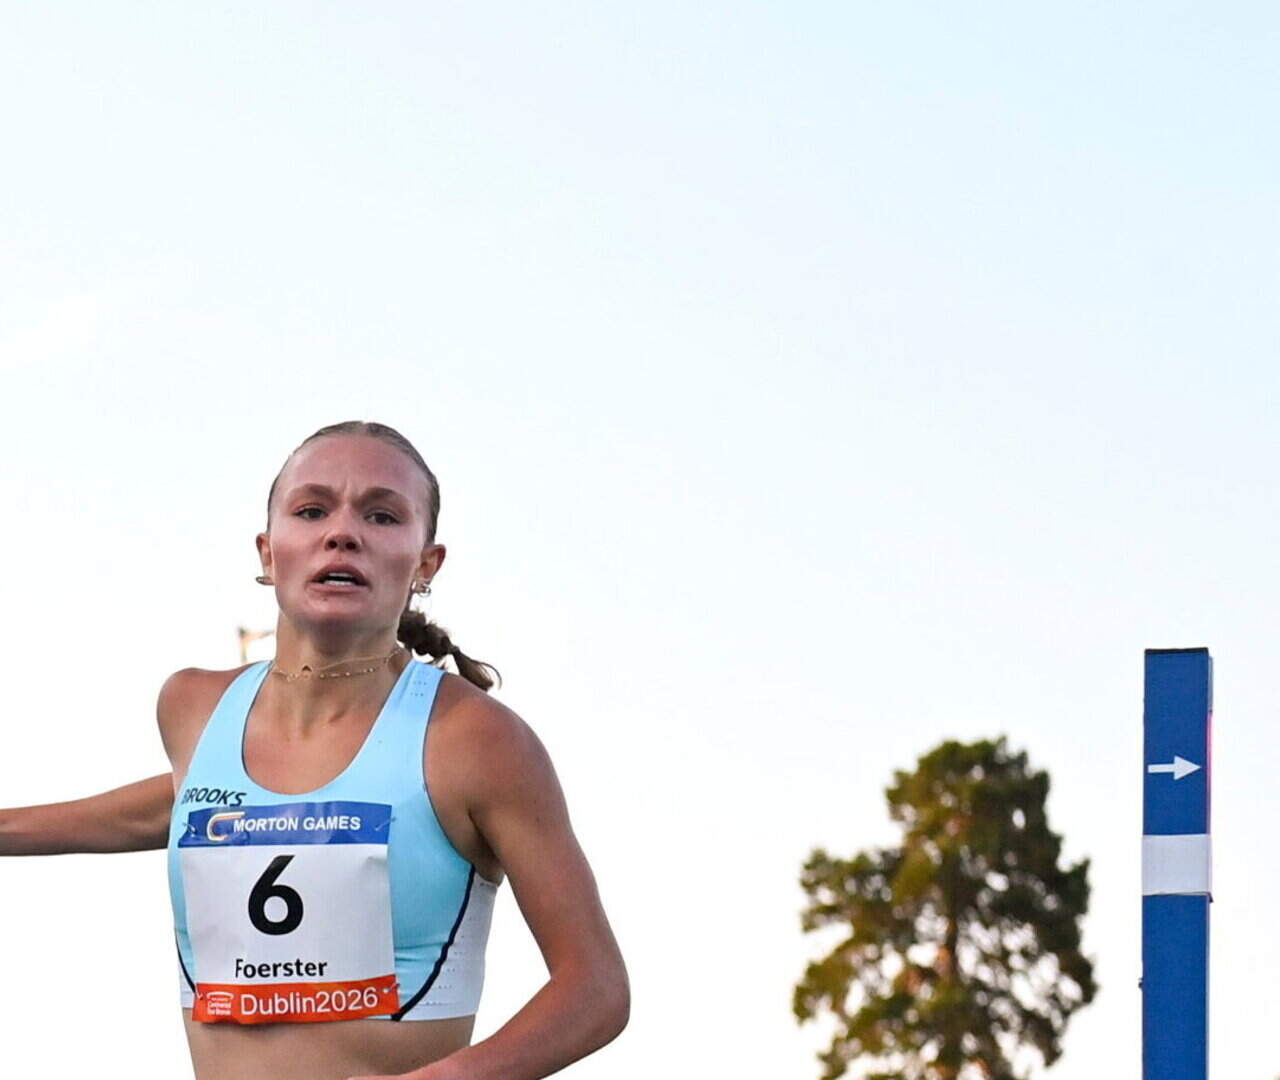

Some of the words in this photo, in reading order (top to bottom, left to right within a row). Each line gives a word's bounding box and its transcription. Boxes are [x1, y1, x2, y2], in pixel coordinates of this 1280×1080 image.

[233, 815, 298, 833] MORTON
[303, 815, 361, 831] GAMES
[248, 855, 304, 935] 6
[235, 958, 327, 979] Foerster
[240, 987, 378, 1016] Dublin2026
